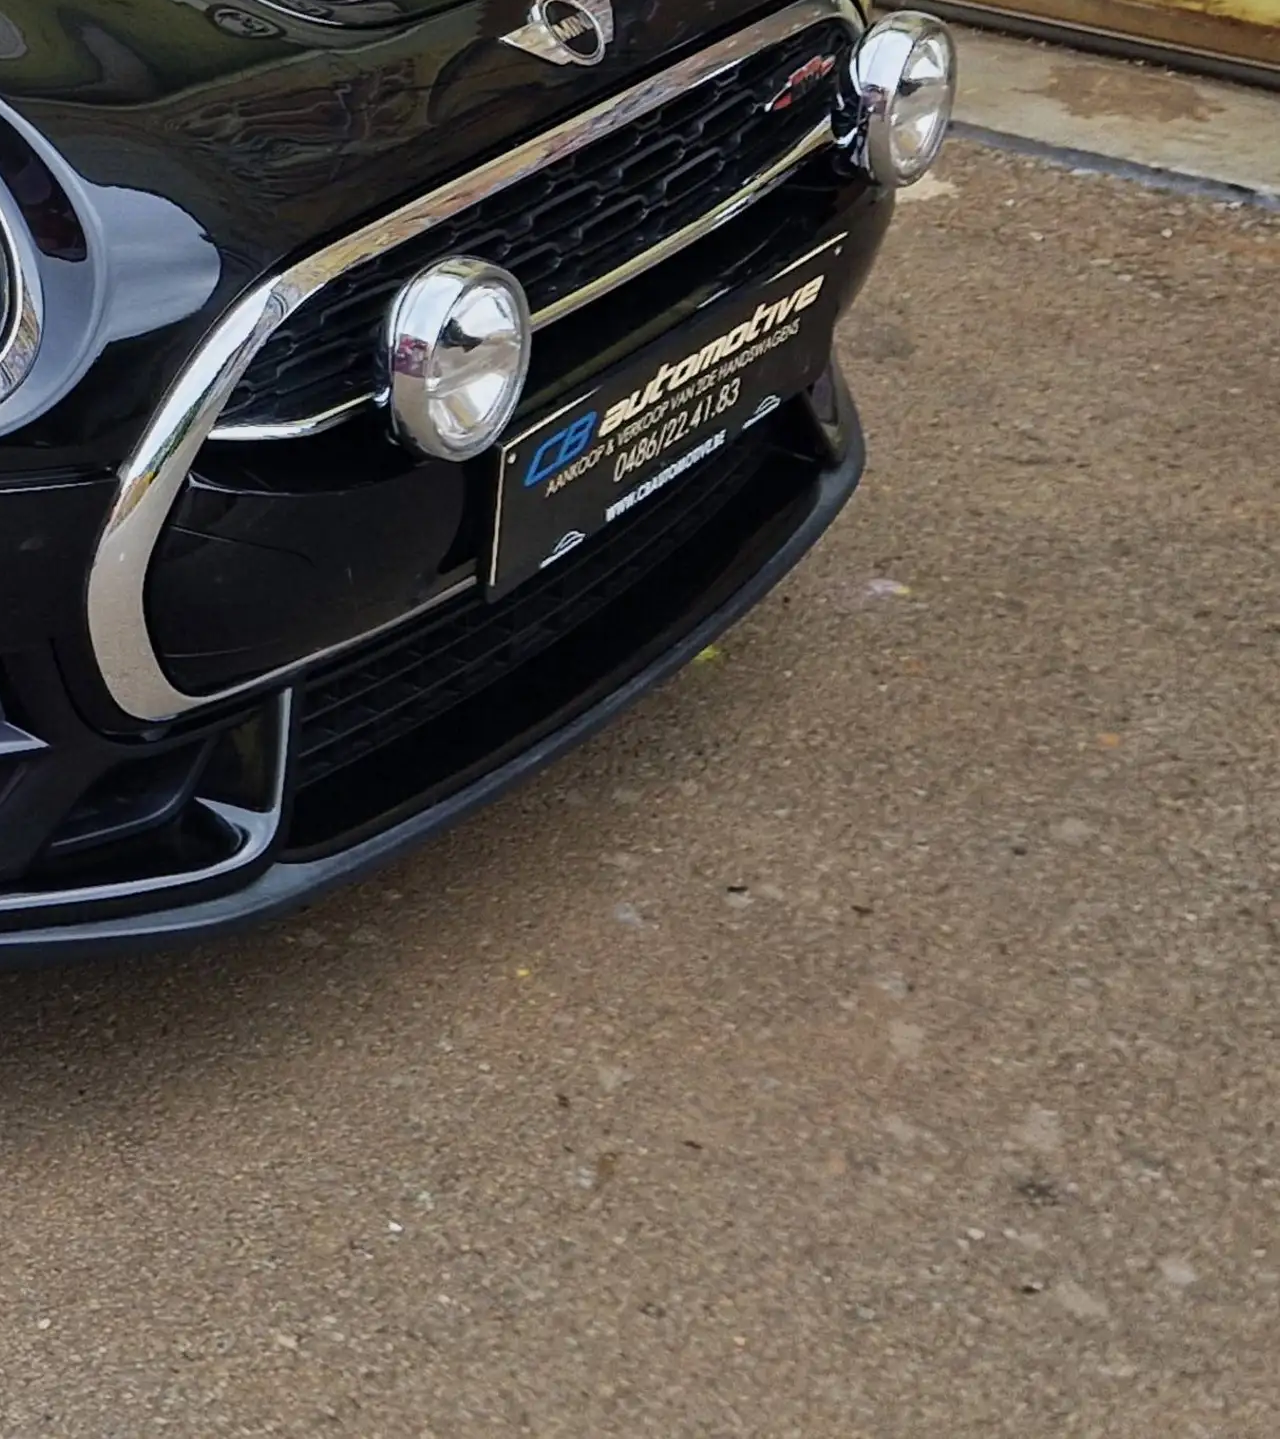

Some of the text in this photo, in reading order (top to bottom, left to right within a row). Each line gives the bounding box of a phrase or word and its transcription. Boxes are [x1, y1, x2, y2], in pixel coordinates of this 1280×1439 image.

[524, 274, 825, 487] CB automotive
[612, 377, 741, 484] 0486/22.41.83
